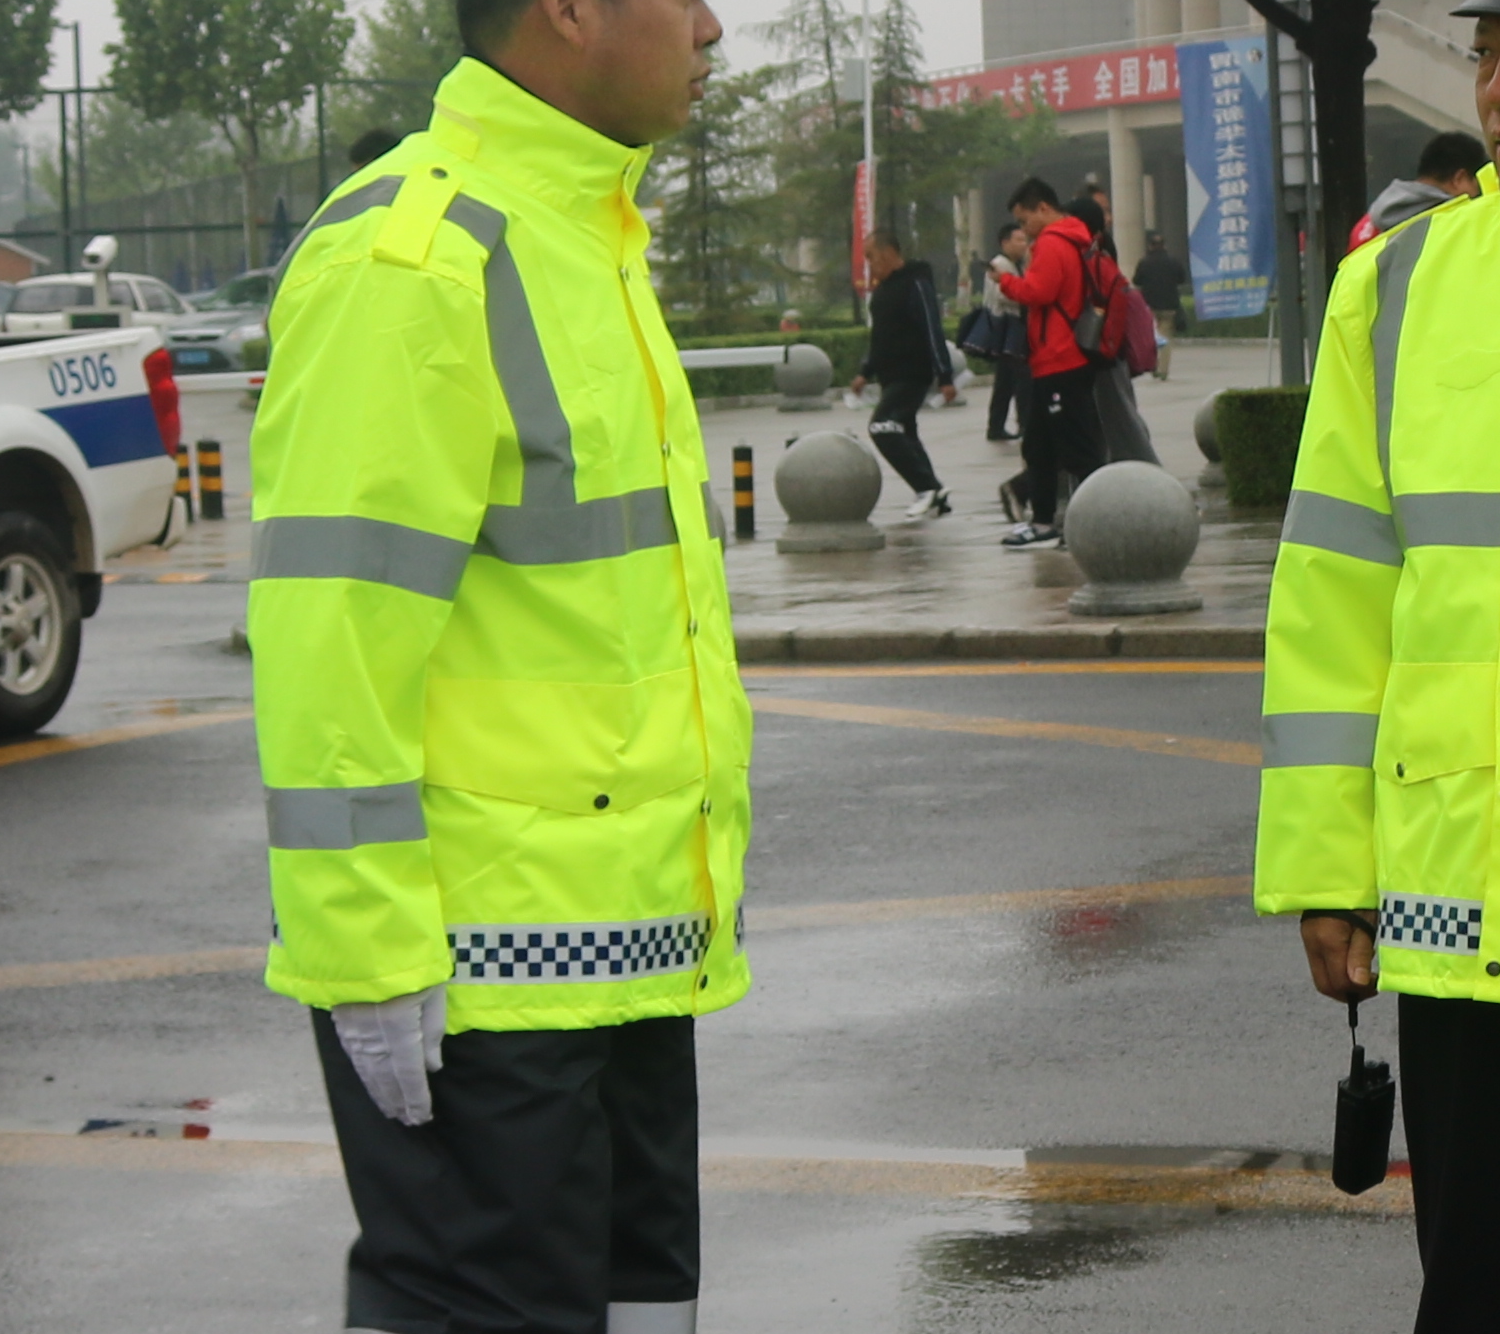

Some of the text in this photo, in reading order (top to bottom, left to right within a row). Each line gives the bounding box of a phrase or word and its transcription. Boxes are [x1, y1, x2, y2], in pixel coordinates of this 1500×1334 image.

[1094, 52, 1181, 101] 全国加
[48, 352, 117, 397] 0506
